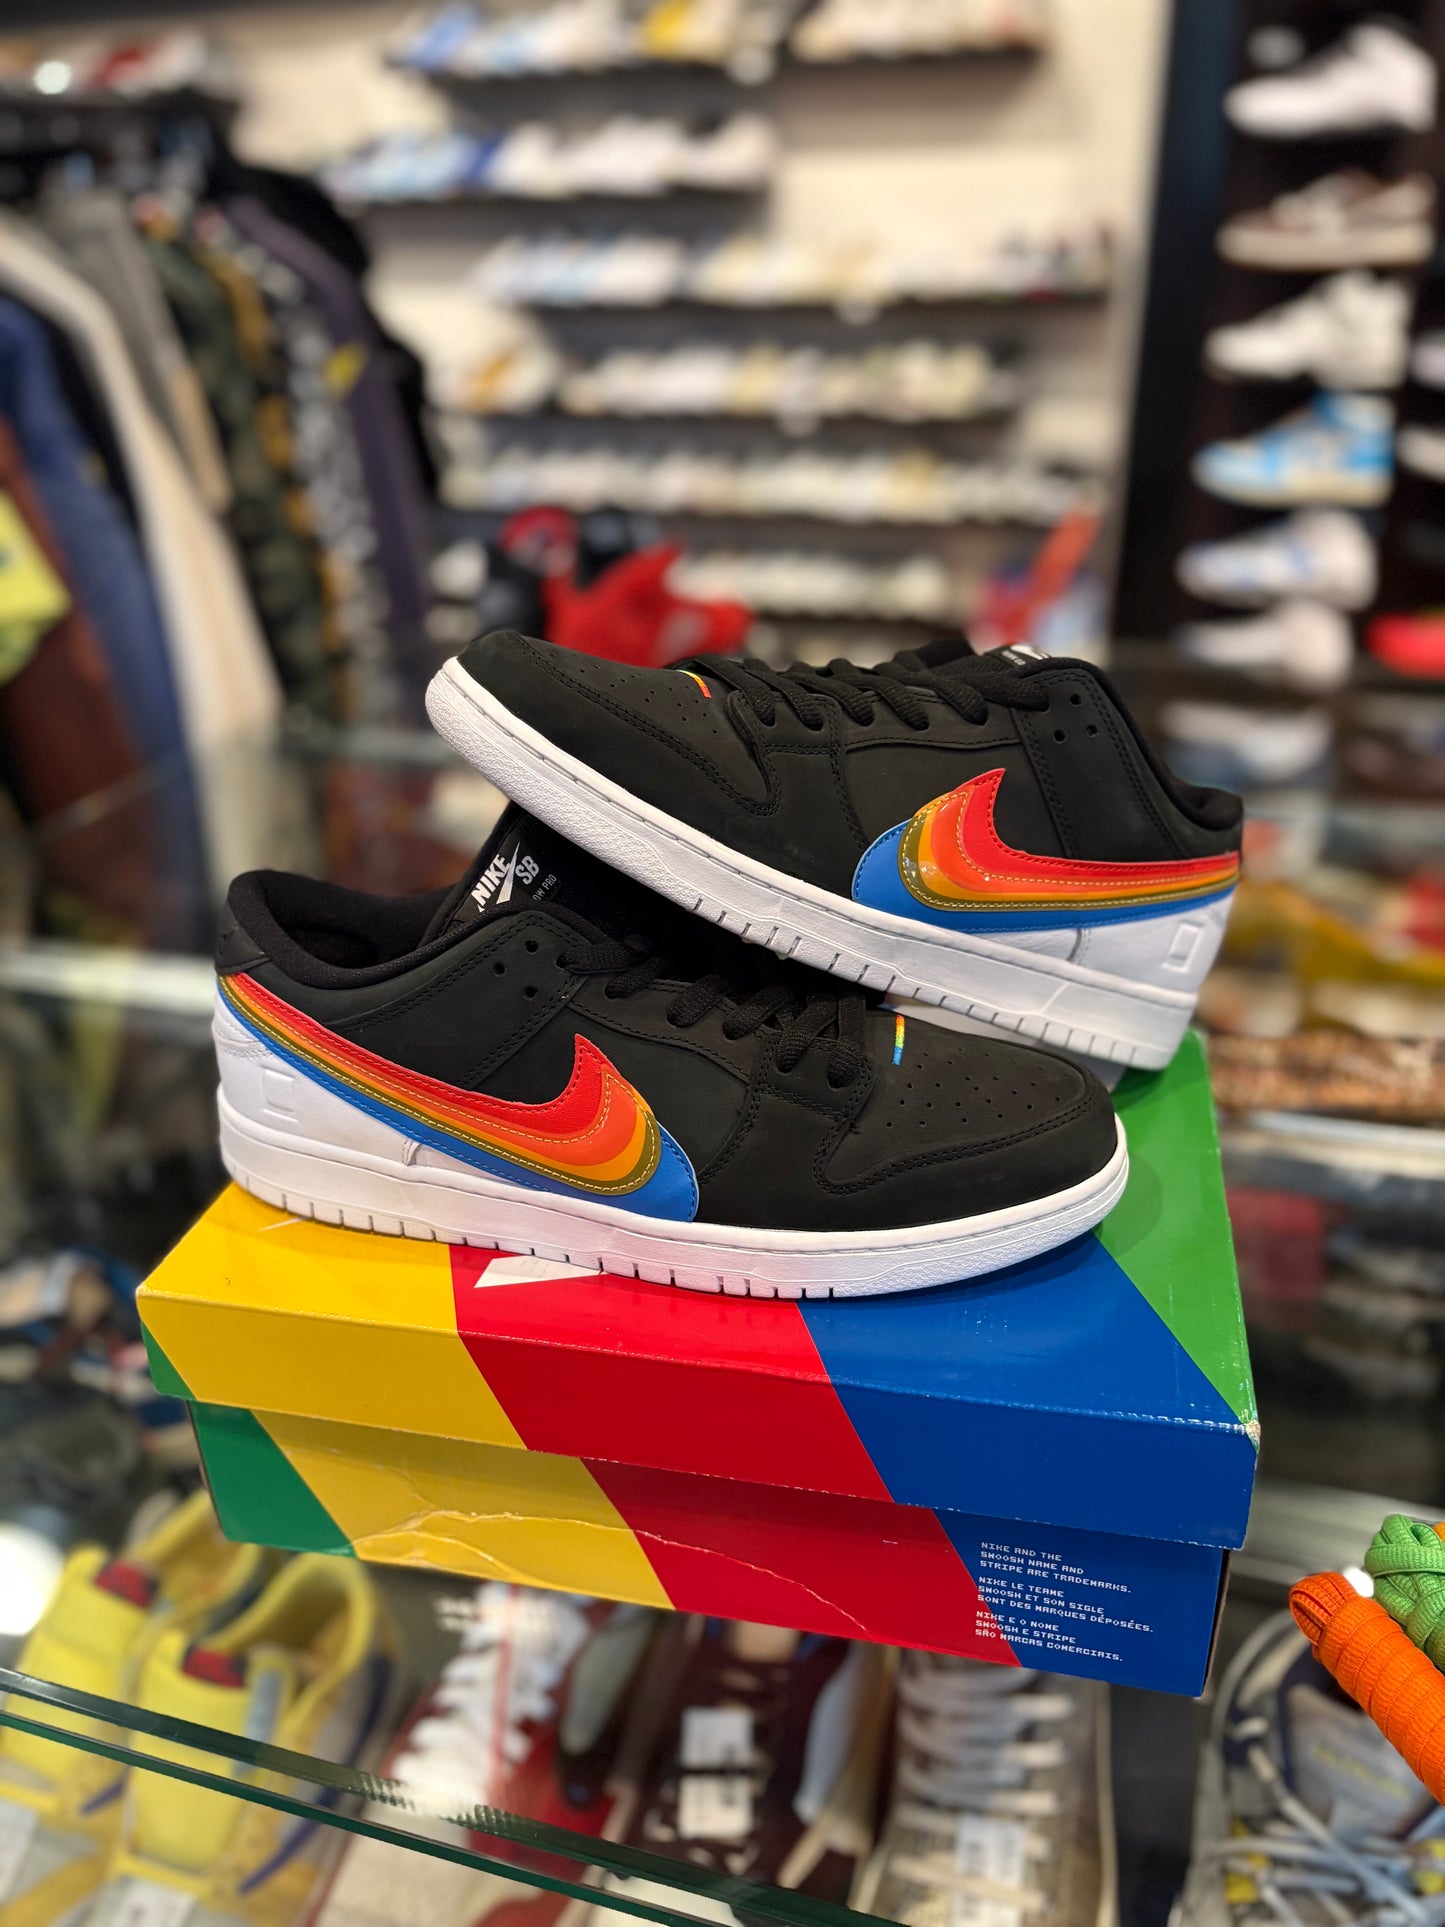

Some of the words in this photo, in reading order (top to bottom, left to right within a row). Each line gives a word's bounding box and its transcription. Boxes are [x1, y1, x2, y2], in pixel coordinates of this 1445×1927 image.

[471, 854, 510, 906] NIKE
[515, 856, 539, 885] SB
[541, 874, 557, 890] PRO
[981, 1541, 1010, 1553] NIKE
[1014, 1547, 1036, 1557] AND
[1040, 1551, 1063, 1561] THE
[981, 1551, 1024, 1565] SWOOSH
[1028, 1559, 1057, 1570] NAME
[1061, 1565, 1084, 1575] AND
[978, 1576, 1007, 1588] NIKE
[1011, 1582, 1024, 1590] LE
[980, 1560, 1023, 1574] STRIPE
[1027, 1568, 1049, 1578] ARE
[1053, 1572, 1131, 1593] TRADEMARKS.
[978, 1585, 1021, 1599] SWOOSH
[1025, 1593, 1039, 1602] ET
[1043, 1597, 1065, 1607] SON
[1069, 1601, 1104, 1614] SIGLE
[976, 1610, 1005, 1622] NIKE
[1008, 1616, 1016, 1624] E
[1030, 1621, 1059, 1632] NOME
[977, 1594, 1006, 1605] SONT
[1009, 1600, 1031, 1610] DES
[1035, 1605, 1086, 1620] MARQUES
[1090, 1614, 1154, 1633] DÉPOSÉES.
[975, 1619, 1018, 1633] SWOOSH
[1033, 1630, 1076, 1644] STRIPE
[975, 1628, 996, 1638] SÃO
[999, 1633, 1043, 1647] MARCAS
[1046, 1641, 1123, 1662] COMERCIAIS.
